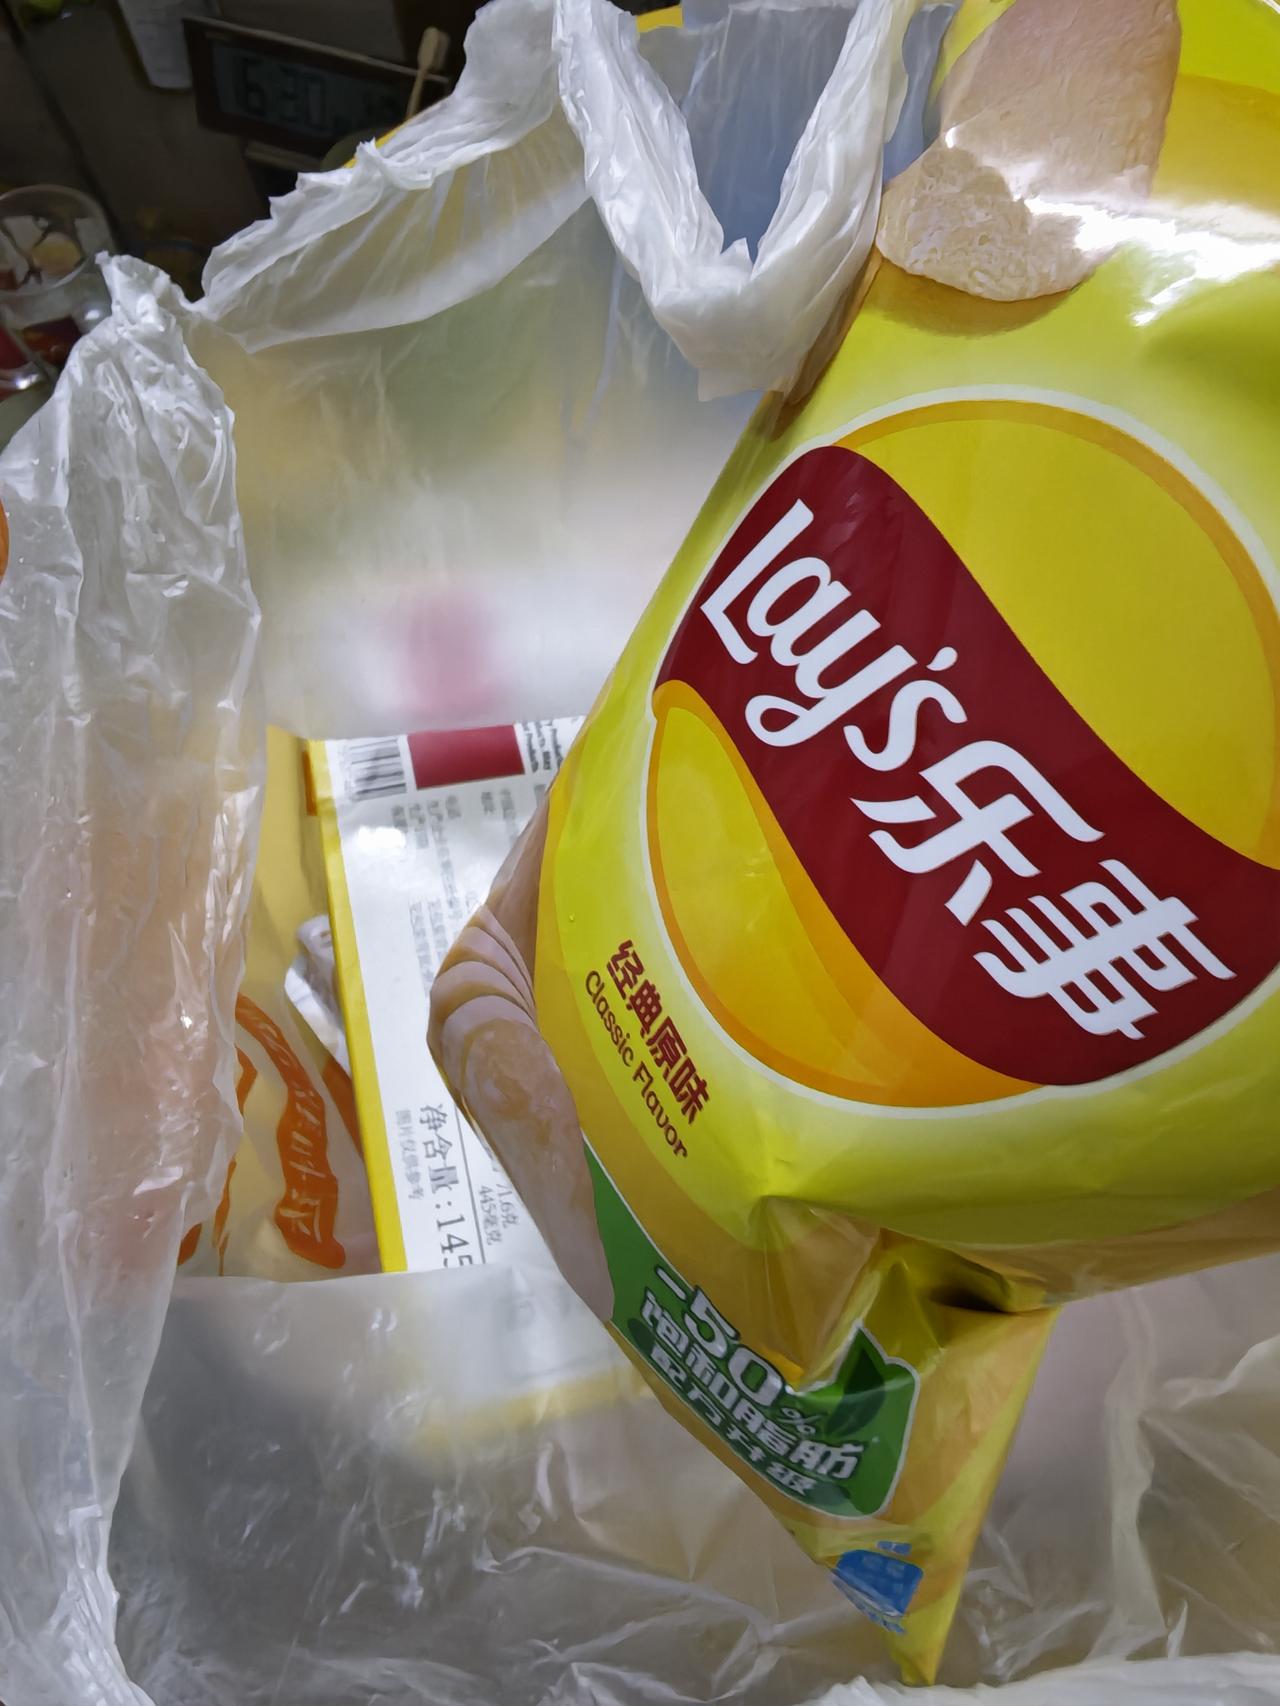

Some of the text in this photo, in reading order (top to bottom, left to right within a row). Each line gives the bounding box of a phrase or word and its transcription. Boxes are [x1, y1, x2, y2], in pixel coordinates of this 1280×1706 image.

[700, 498, 968, 772] Lay's
[850, 740, 1237, 1041] 乐事
[585, 970, 688, 1158] Classic Flavor
[607, 939, 710, 1125] 经典原味
[640, 1288, 864, 1479] 饱和脂肪
[650, 1344, 818, 1496] 配方升级
